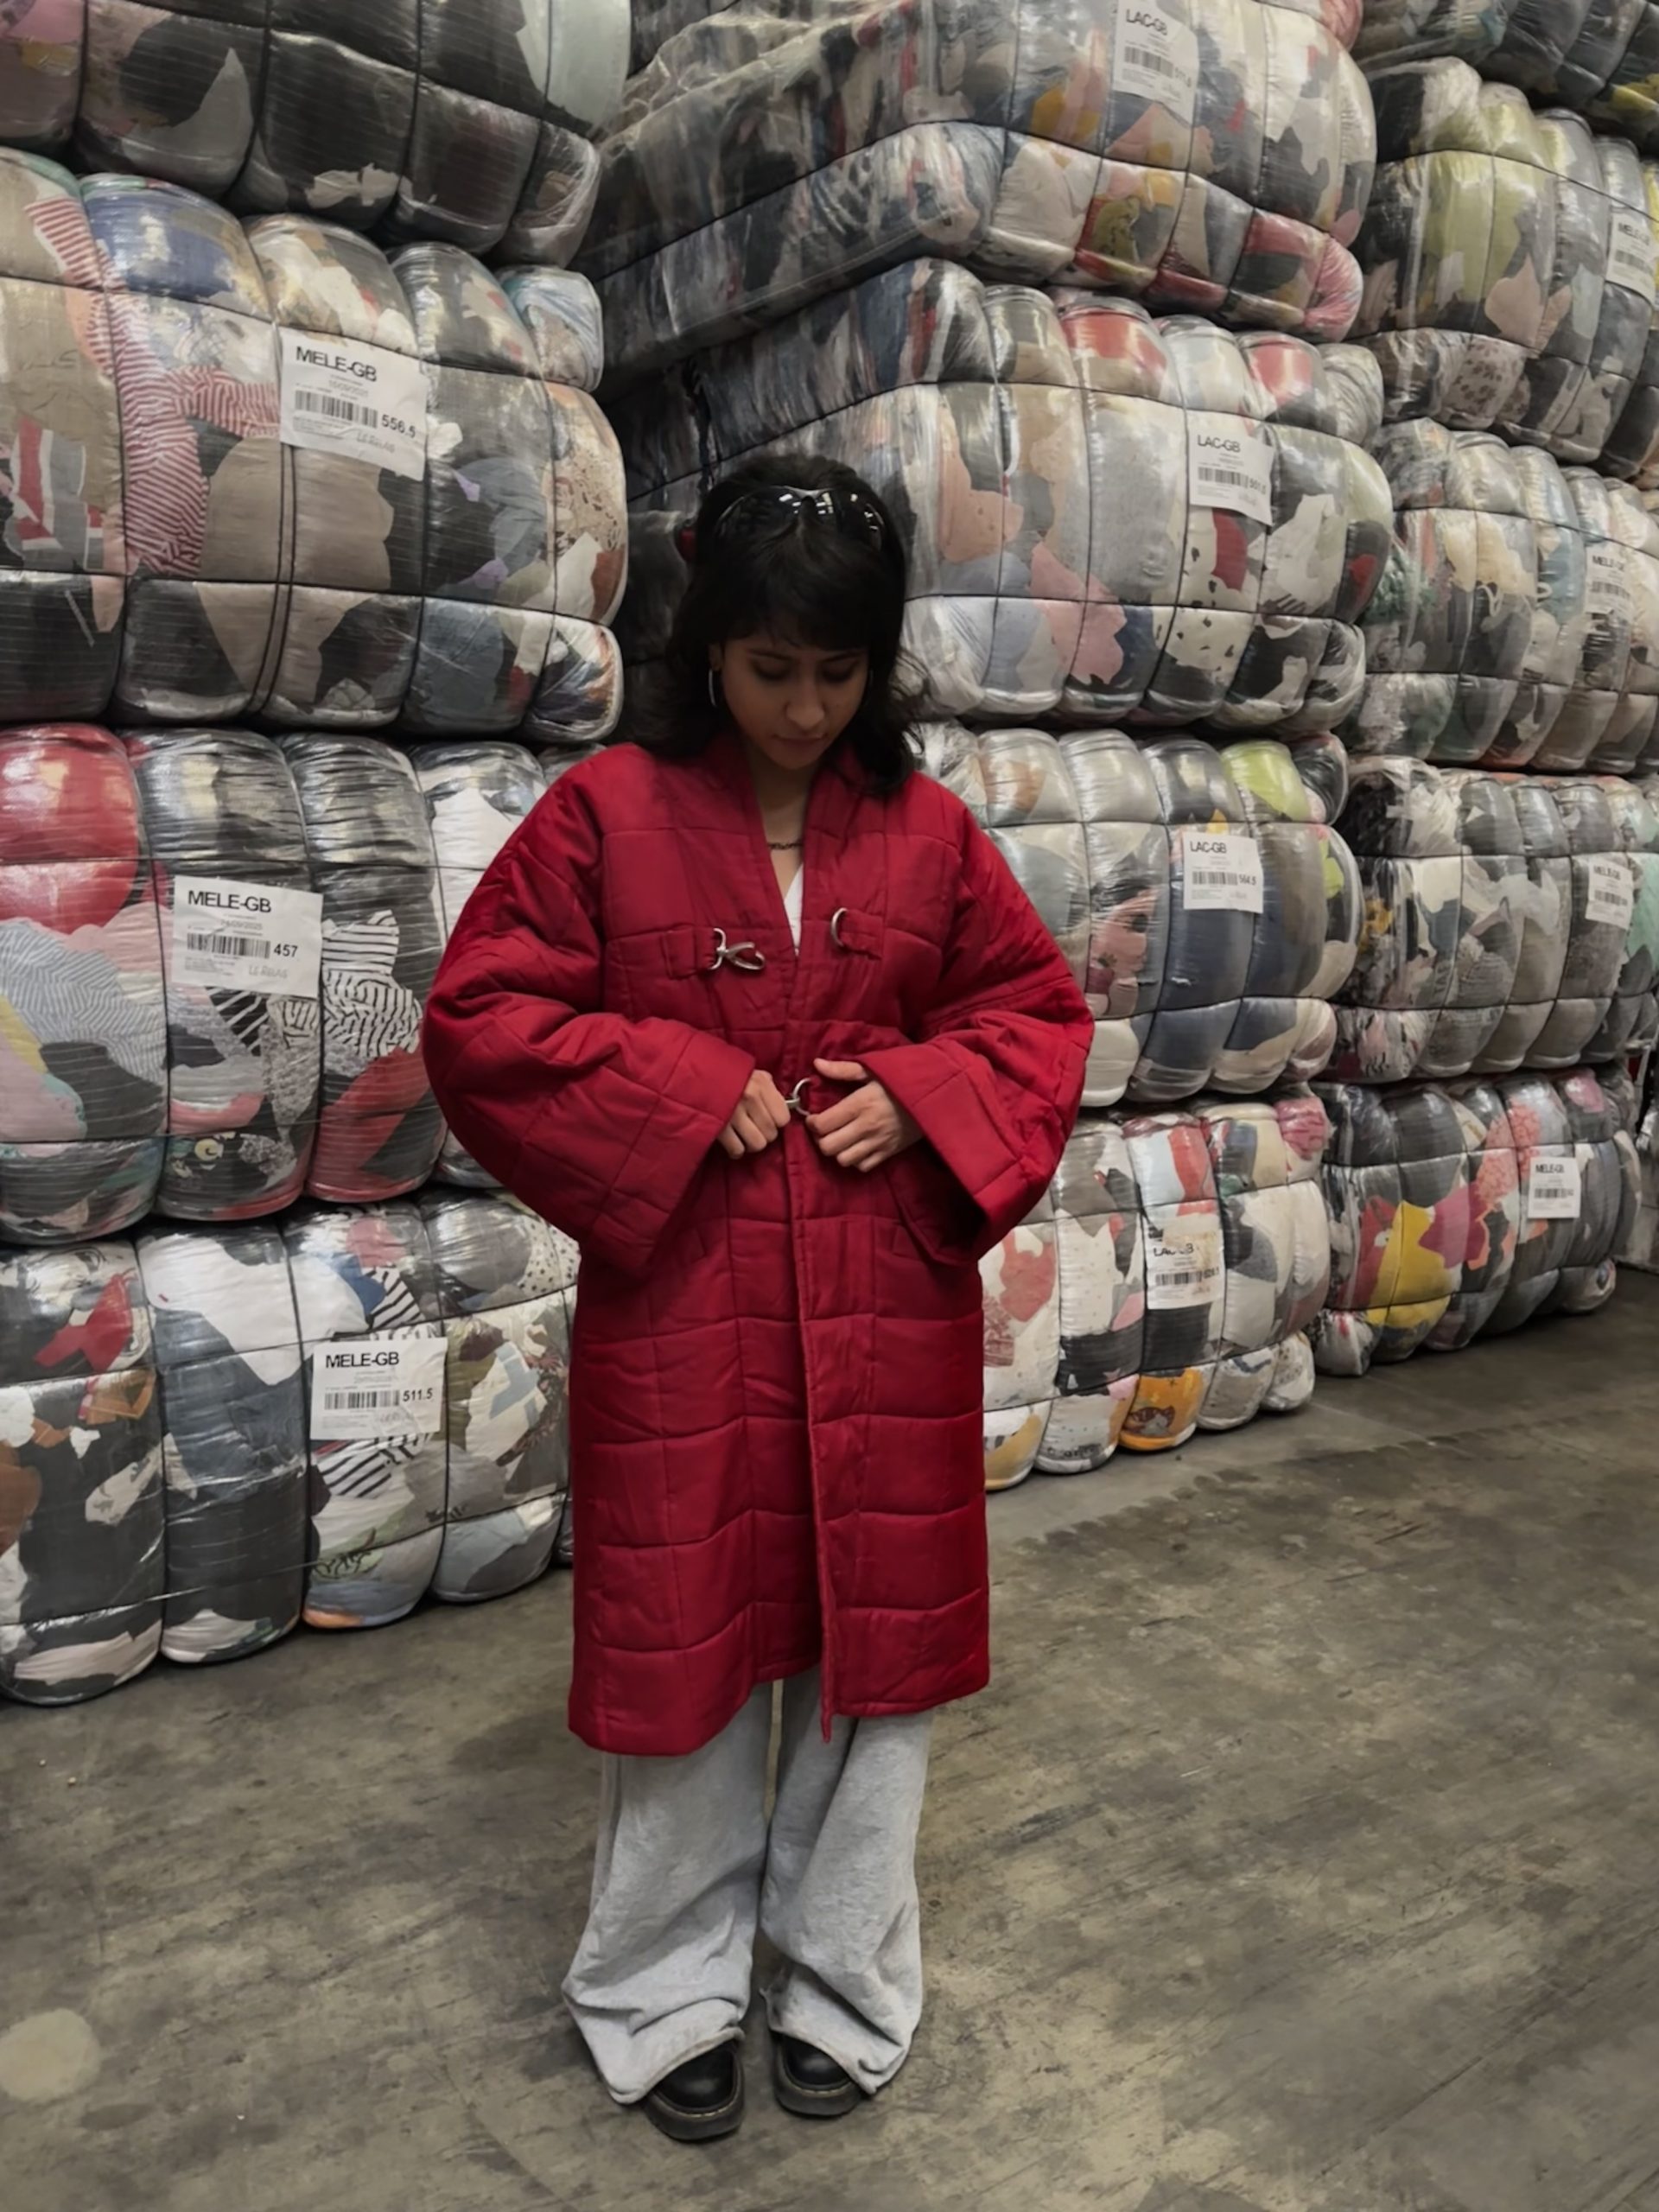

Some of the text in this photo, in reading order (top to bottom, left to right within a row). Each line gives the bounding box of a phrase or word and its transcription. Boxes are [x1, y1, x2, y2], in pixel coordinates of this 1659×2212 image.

[296, 346, 378, 382] MELE-GB
[381, 414, 416, 438] 556.5
[1197, 435, 1241, 453] LAC-GB
[1190, 841, 1227, 854] LAC-GB
[188, 890, 272, 913] MELE-GB
[274, 944, 298, 957] 457
[326, 1351, 399, 1369] MELE-GB
[403, 1388, 433, 1402] 511.5
